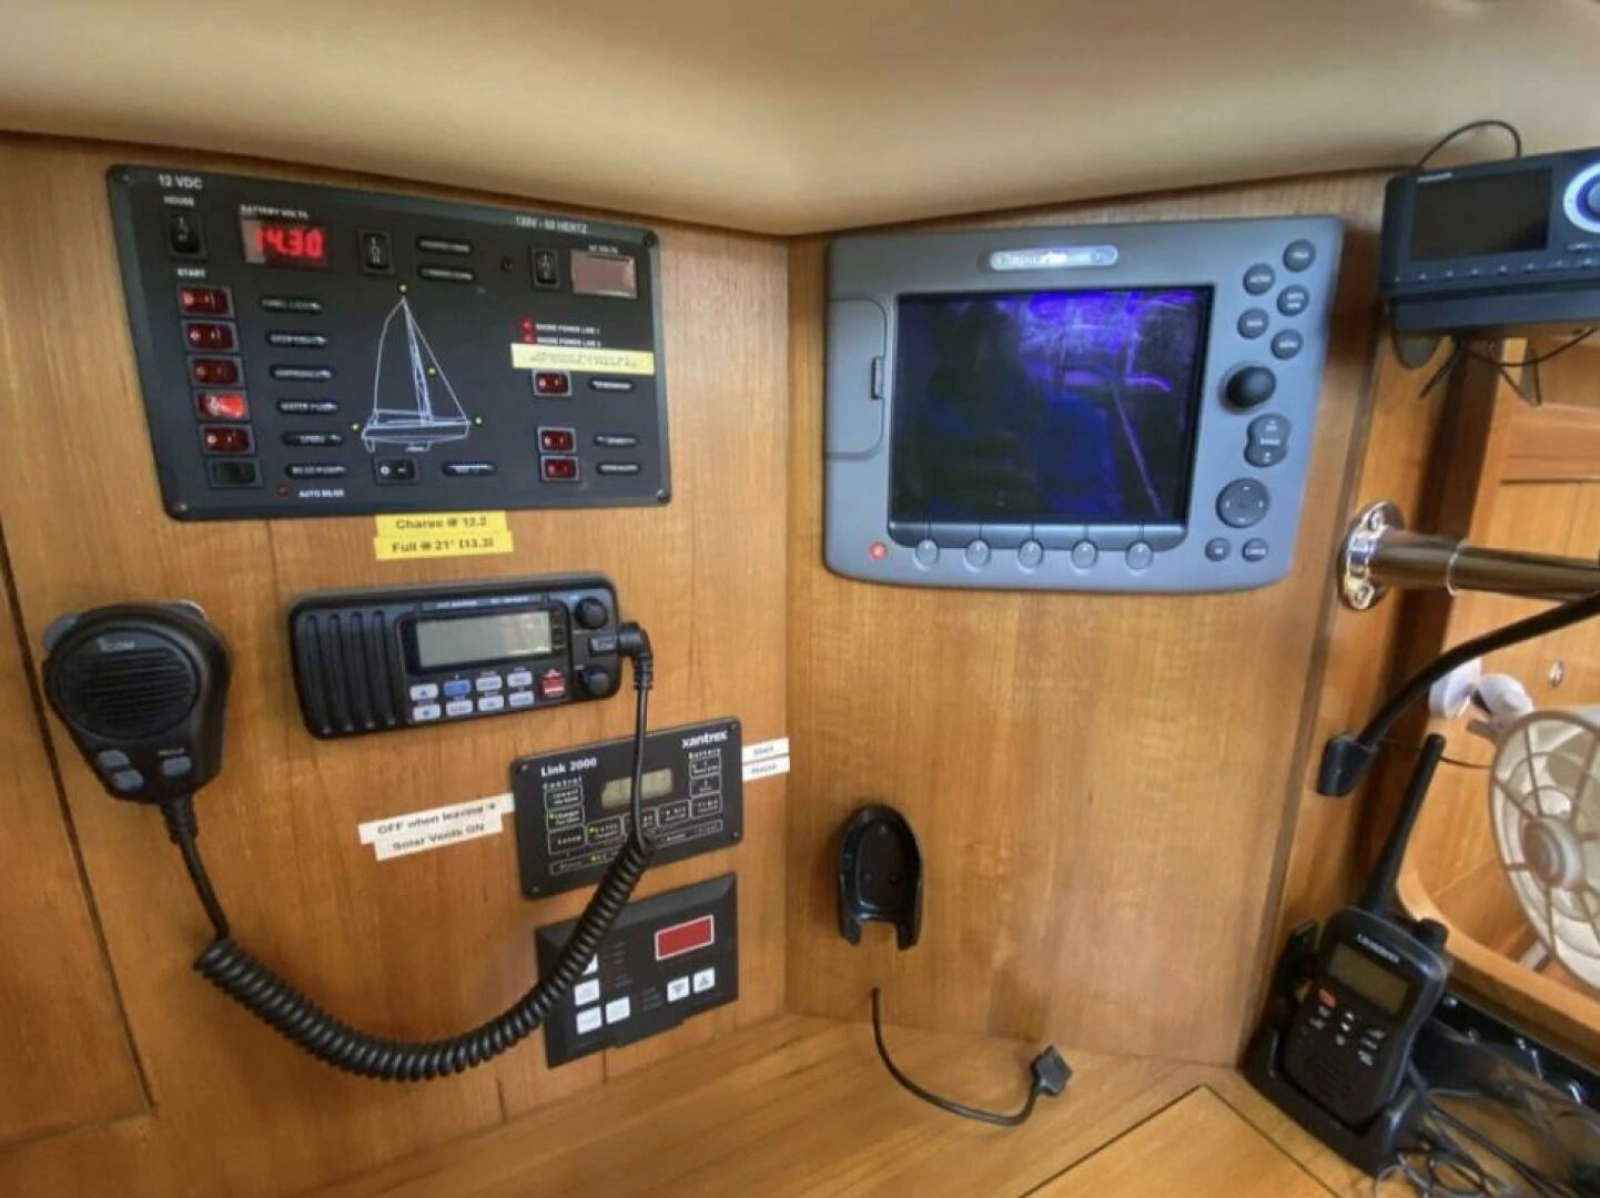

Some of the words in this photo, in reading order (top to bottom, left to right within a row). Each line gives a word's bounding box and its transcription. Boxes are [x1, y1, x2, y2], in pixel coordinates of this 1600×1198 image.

[174, 175, 203, 190] VDC
[255, 227, 323, 258] 14.30
[462, 515, 487, 528] 12.2
[391, 541, 417, 553] Full
[681, 731, 729, 749] xantrex
[540, 763, 567, 778] Link
[377, 822, 404, 835] OFF
[407, 814, 439, 829] when
[392, 837, 426, 851] Solar
[428, 828, 464, 843] Vents
[465, 822, 485, 835] ON
